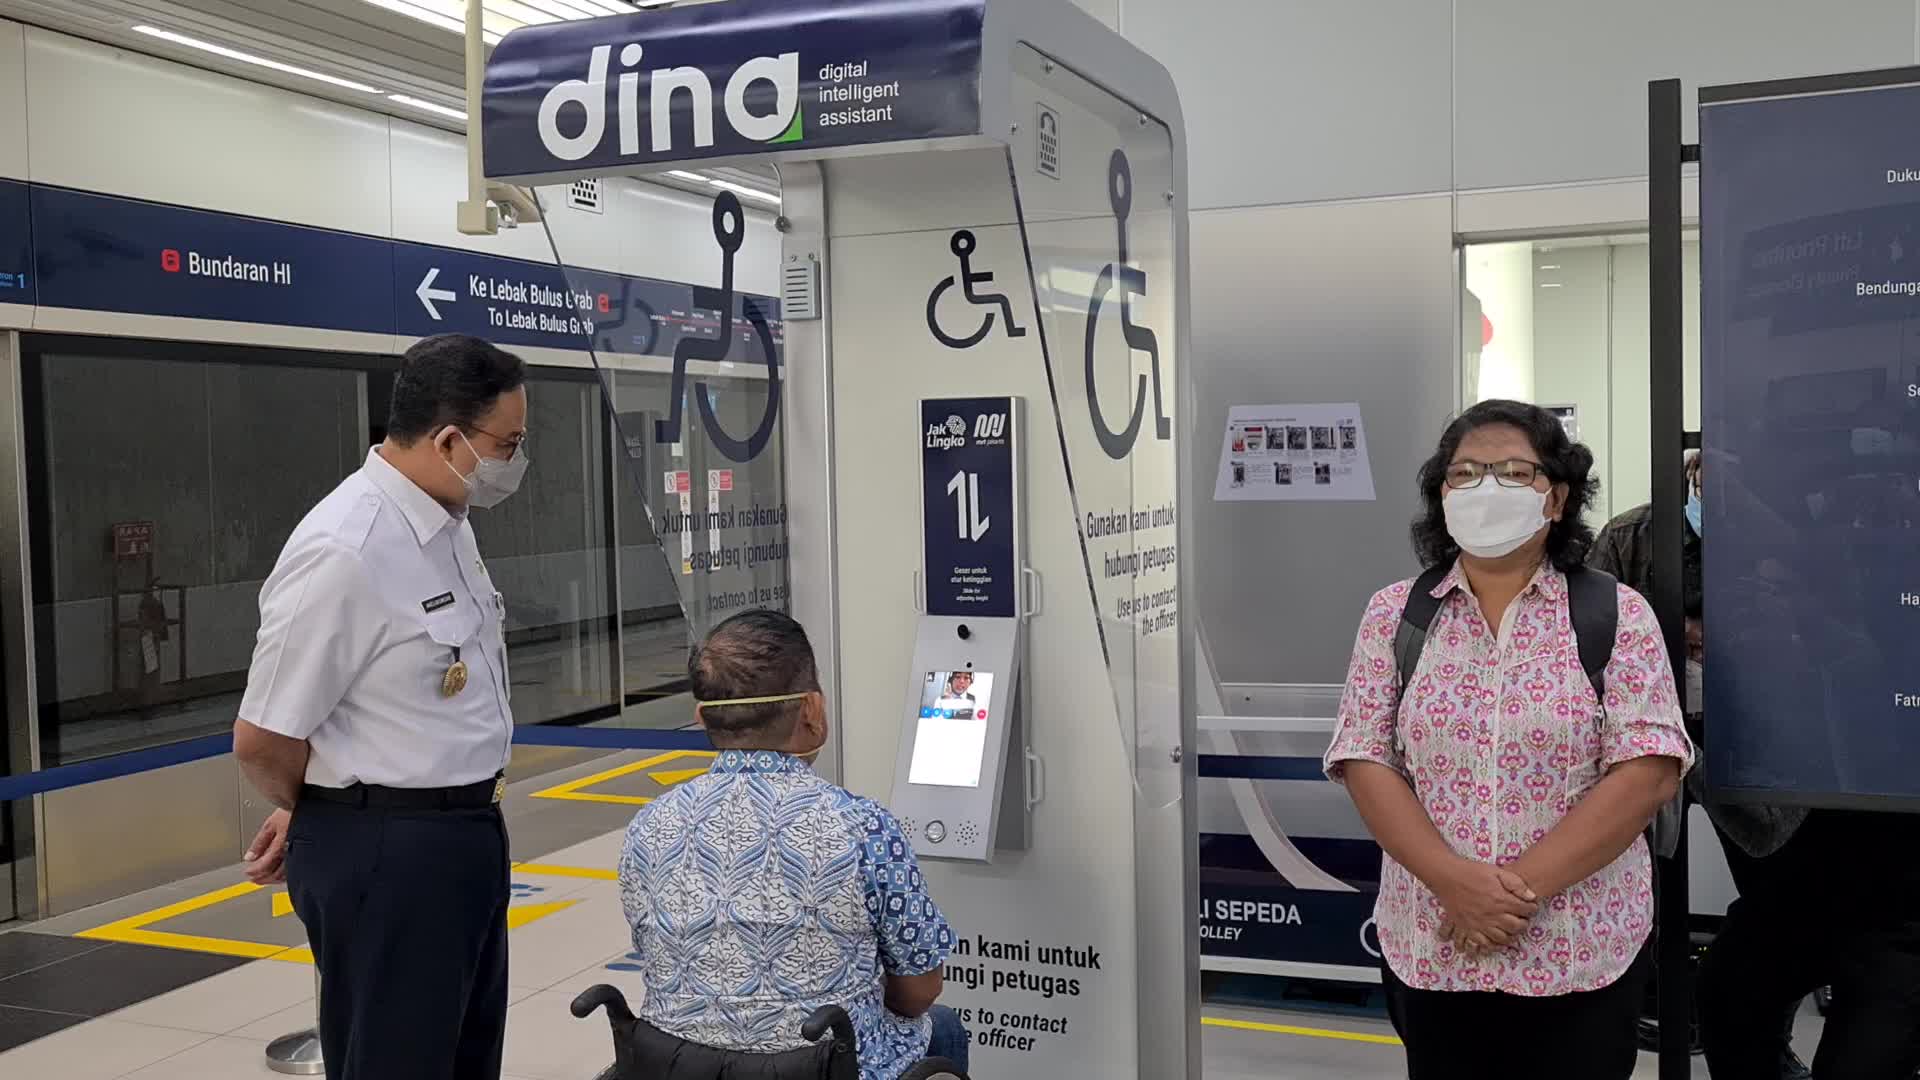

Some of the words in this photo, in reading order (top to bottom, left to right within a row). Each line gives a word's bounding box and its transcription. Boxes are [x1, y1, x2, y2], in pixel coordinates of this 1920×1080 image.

[818, 60, 868, 83] digital
[538, 43, 801, 161] dina
[818, 81, 900, 104] intelligent
[818, 104, 893, 127] assistant
[1887, 168, 1920, 183] Duku
[17, 272, 25, 289] 1
[188, 251, 269, 283] Bundaran
[273, 263, 291, 285] HI
[469, 274, 487, 298] Ke
[490, 277, 528, 303] Lebak
[530, 283, 563, 307] Bulus
[488, 307, 503, 326] To
[505, 309, 538, 330] Lebak
[539, 314, 568, 333] Bulus
[926, 423, 947, 436] Jak
[926, 435, 966, 450] Lingko
[1086, 507, 1128, 539] Gunakan
[1129, 505, 1151, 532] kami
[1152, 501, 1175, 528] untuk
[1104, 547, 1141, 579] hubungi
[1142, 545, 1176, 576] petugas
[1117, 598, 1131, 619] Use
[1132, 597, 1142, 614] us
[1143, 594, 1150, 611] to
[1151, 586, 1176, 608] contact
[1142, 616, 1154, 637] the
[1155, 610, 1177, 631] officer
[1215, 899, 1302, 926] SEPEDA
[977, 934, 1030, 962] kami
[1038, 945, 1101, 970] untuk
[992, 968, 1081, 998] petugas
[977, 1007, 994, 1025] to
[1000, 1012, 1068, 1034] contact
[978, 1028, 1036, 1052] officer
